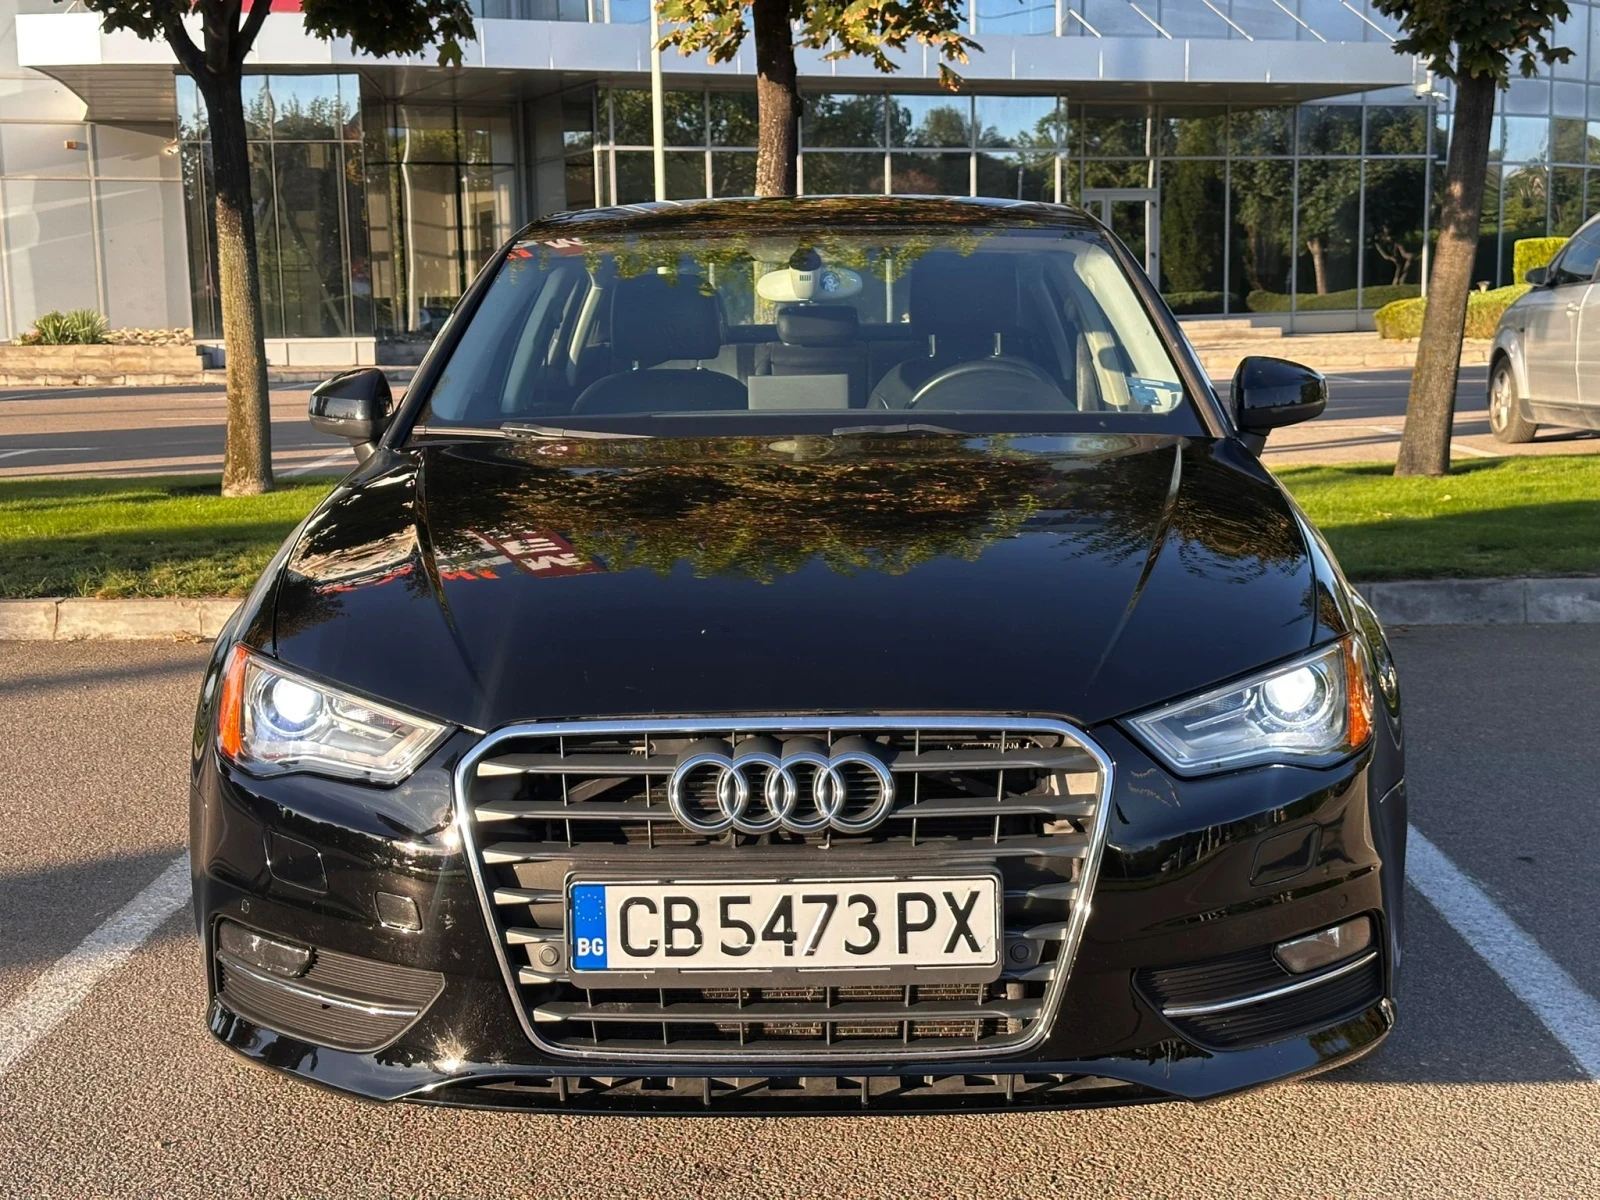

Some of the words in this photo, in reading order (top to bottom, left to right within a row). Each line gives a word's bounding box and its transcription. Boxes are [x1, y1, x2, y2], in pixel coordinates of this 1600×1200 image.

[619, 896, 703, 957] CB
[719, 893, 881, 957] 5473
[897, 890, 982, 955] PX
[577, 937, 604, 957] BG
